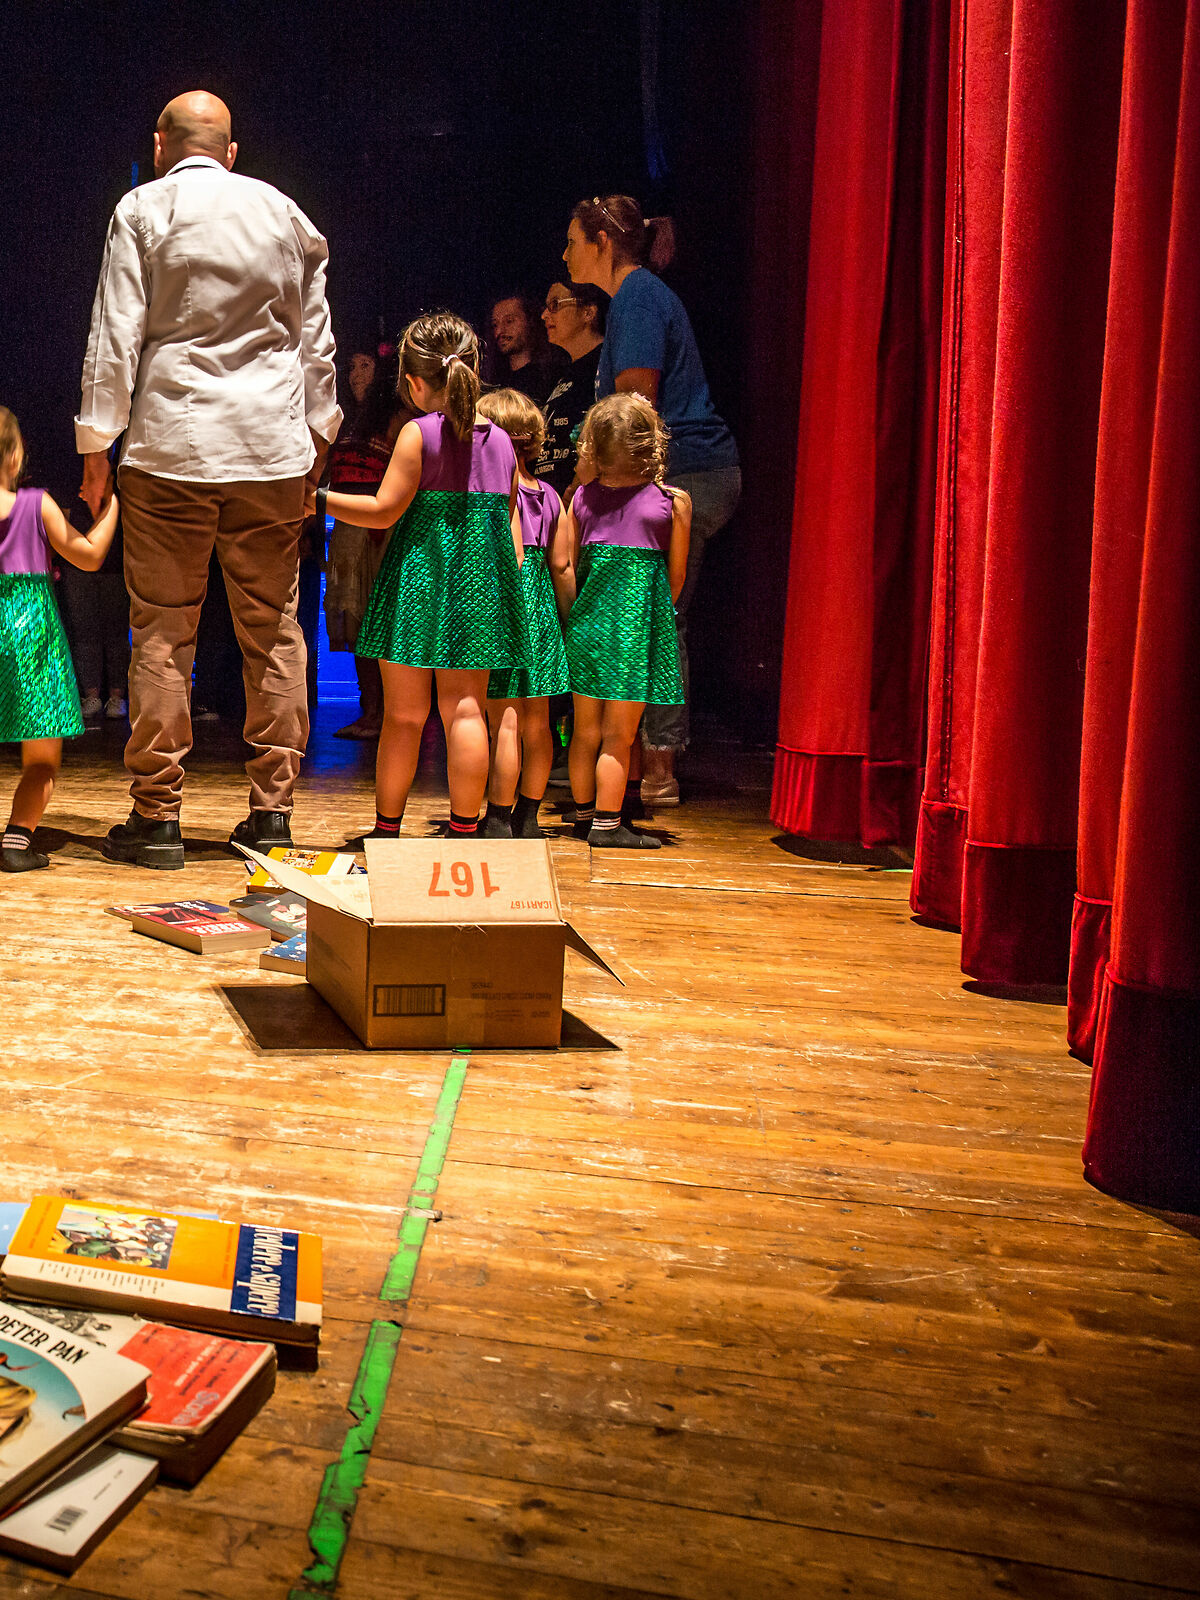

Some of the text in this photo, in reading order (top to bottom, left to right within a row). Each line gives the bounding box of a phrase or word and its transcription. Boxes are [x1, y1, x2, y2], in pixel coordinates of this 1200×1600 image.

[428, 861, 500, 898] 167
[510, 900, 553, 910] ICAR1167
[250, 1264, 274, 1272] e
[236, 1270, 282, 1315] sapere
[47, 1340, 89, 1365] PAN
